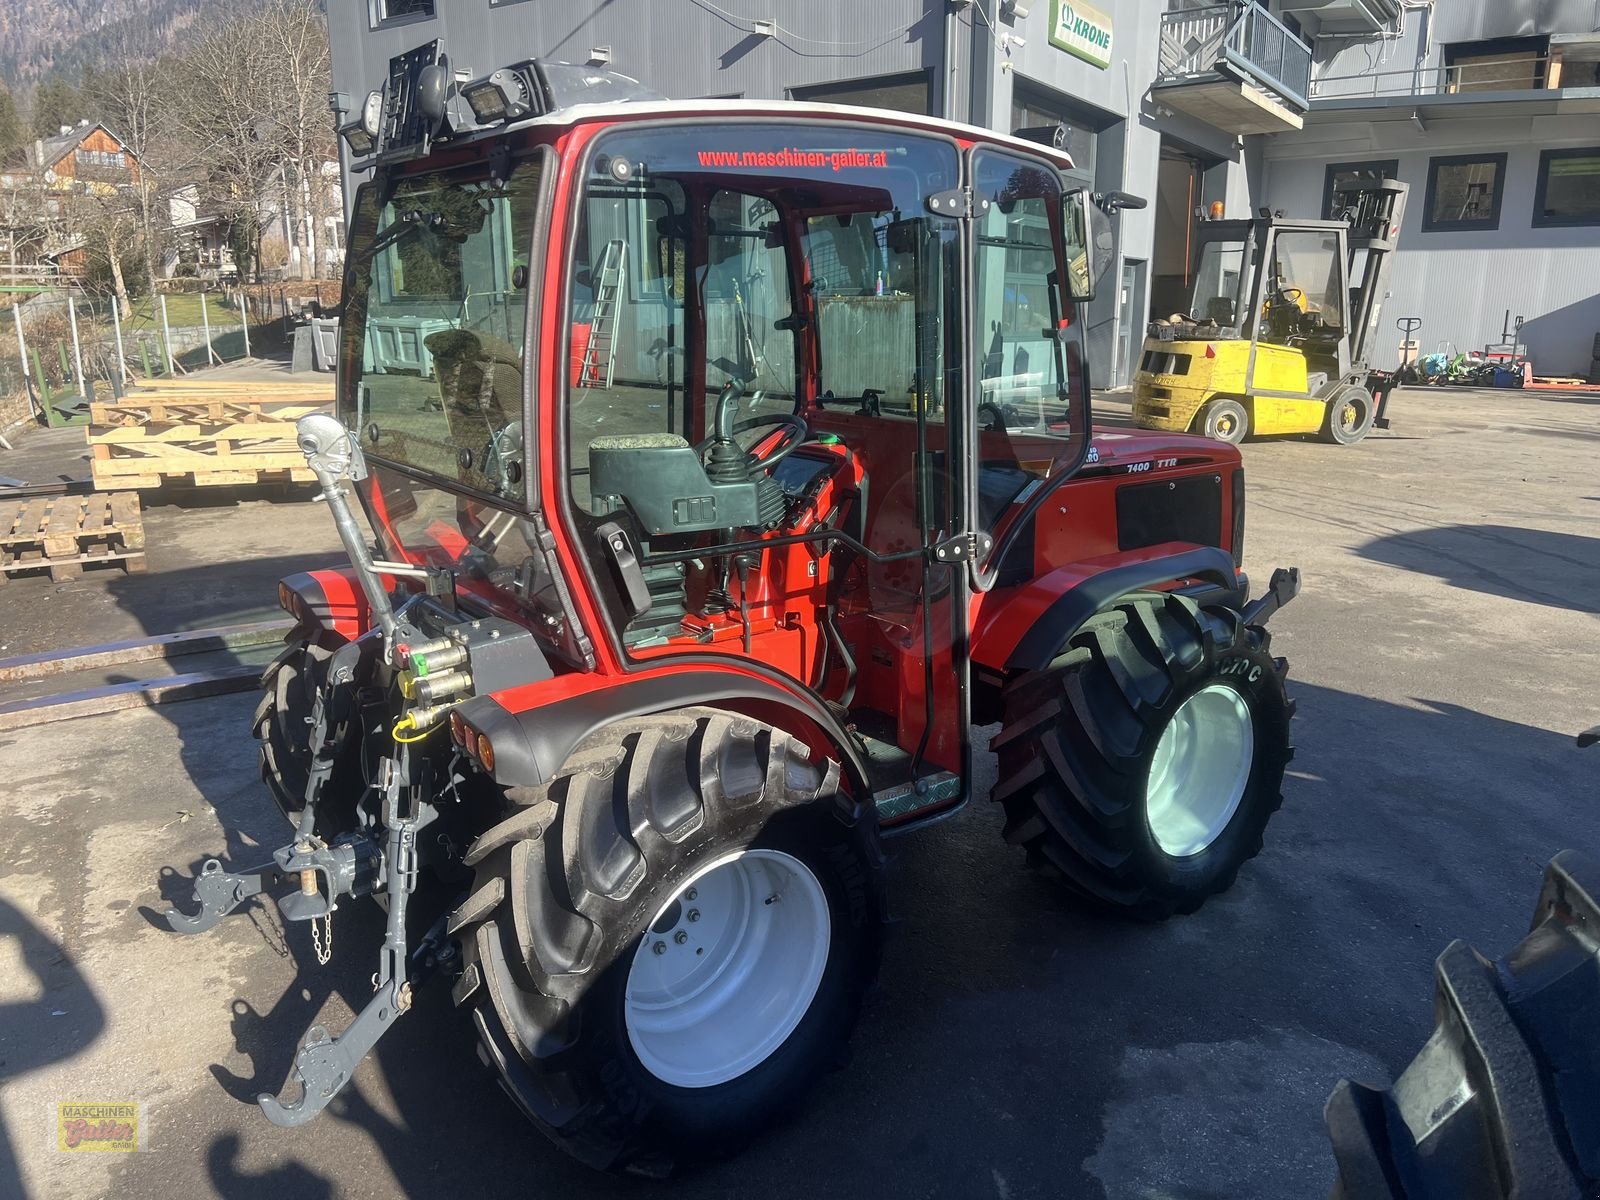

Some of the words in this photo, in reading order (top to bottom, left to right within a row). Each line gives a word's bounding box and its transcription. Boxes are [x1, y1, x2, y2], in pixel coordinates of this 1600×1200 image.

[1073, 17, 1110, 49] KRONE
[698, 147, 888, 171] www.maschinen-gailer.at
[1127, 462, 1150, 473] 7400
[1157, 458, 1177, 468] TTR
